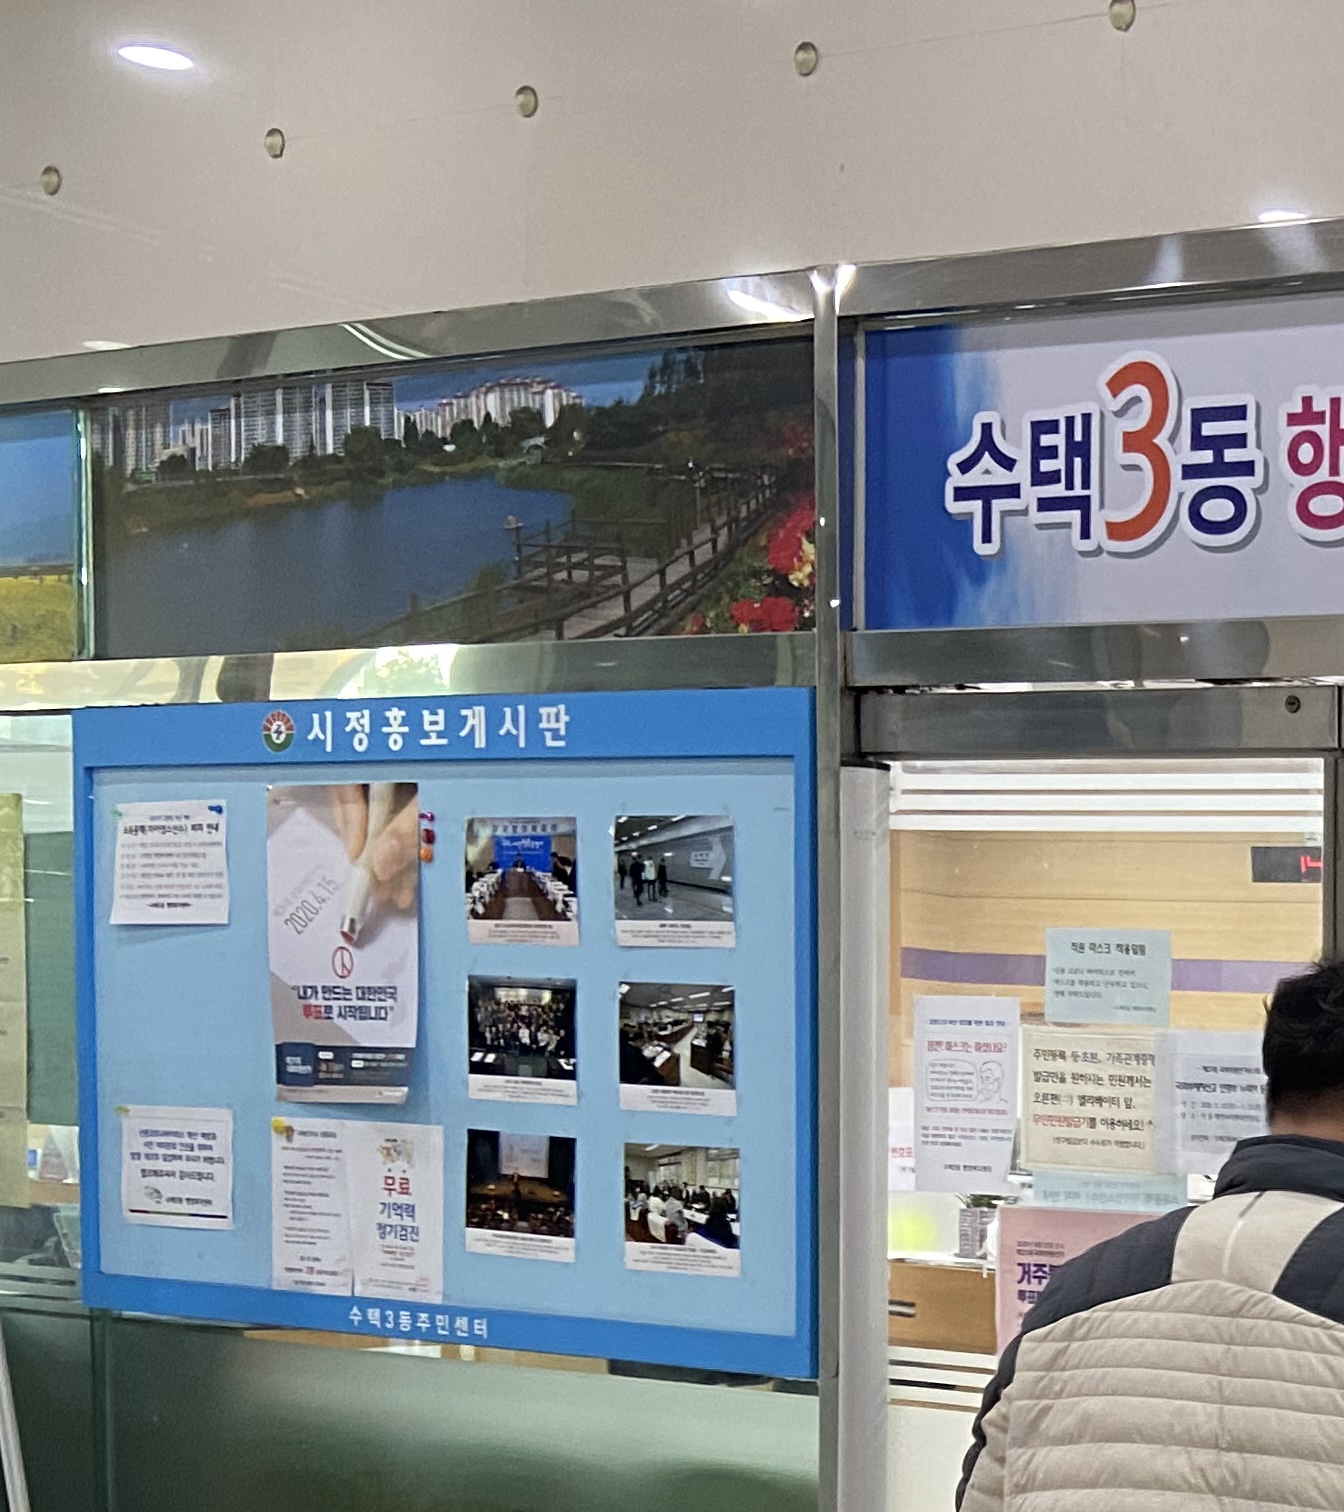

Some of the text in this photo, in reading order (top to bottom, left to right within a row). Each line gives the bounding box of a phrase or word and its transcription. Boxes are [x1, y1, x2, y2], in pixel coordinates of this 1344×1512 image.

[948, 356, 1260, 548] 수택3동
[307, 703, 570, 753] 시정홍보게시판
[382, 1175, 412, 1197] 무료
